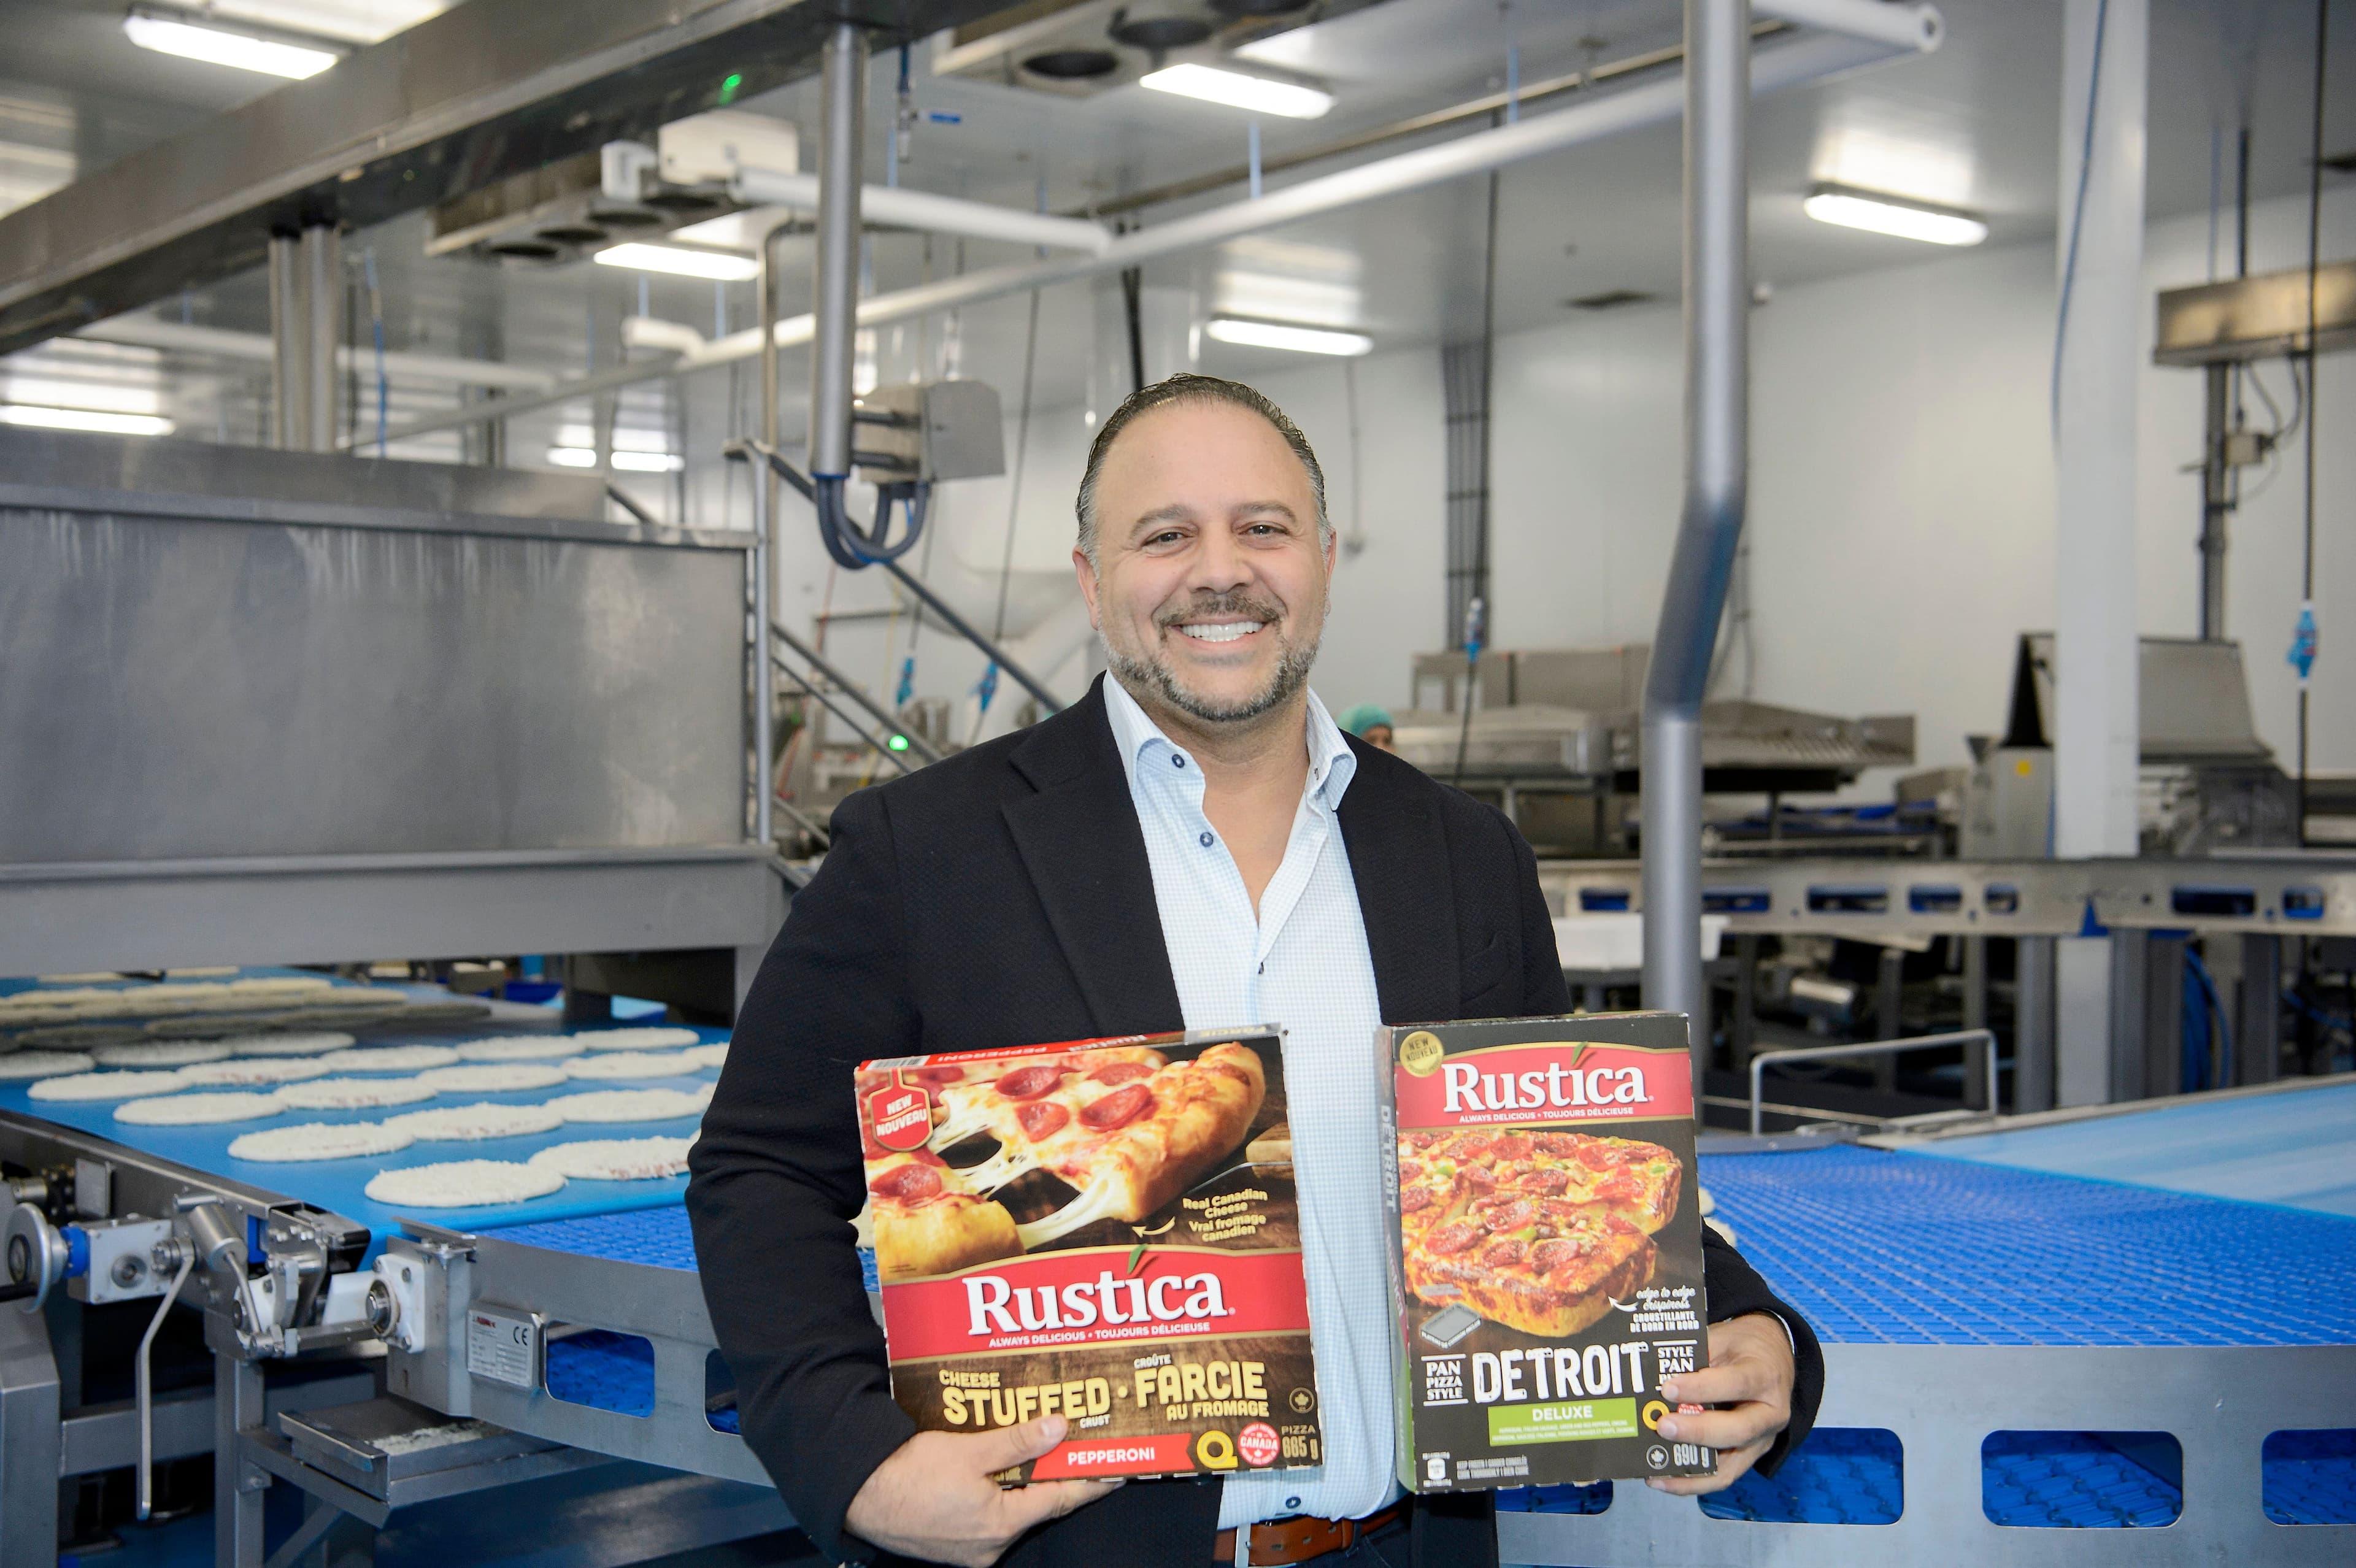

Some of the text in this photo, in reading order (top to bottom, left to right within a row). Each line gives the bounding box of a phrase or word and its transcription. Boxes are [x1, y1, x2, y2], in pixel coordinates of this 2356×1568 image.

[1441, 1062, 1648, 1113] Rustica
[887, 1094, 912, 1115] NEW
[876, 1108, 928, 1137] NOUVEAU
[1459, 1107, 1634, 1123] ALWAYS DELICIOUS TOUJOURS DÉLICIEUSE
[1182, 1188, 1268, 1210] Real Canadian
[1204, 1202, 1249, 1218] Cheese
[1188, 1214, 1267, 1232] Vrai fromage
[1202, 1225, 1257, 1242] canadien
[962, 1270, 1228, 1335] Rustica
[1636, 1285, 1696, 1302] edge to edge
[988, 1321, 1211, 1348] ALWAYS DELICIOUS TOUJOURS DÉLICIEUSE
[1658, 1345, 1694, 1358] STYLE
[1426, 1360, 1461, 1377] PAN
[1472, 1342, 1649, 1404] DETROIT
[1658, 1358, 1694, 1373] PAN
[938, 1369, 1000, 1388] CHEESE
[1134, 1361, 1268, 1407] FARCIE
[1426, 1375, 1463, 1389] PIZZA
[942, 1377, 1111, 1427] STUFFED
[1426, 1387, 1463, 1401] STYLE
[1166, 1400, 1269, 1421] AU FROMAGE
[1532, 1405, 1593, 1422] DELUXE
[1080, 1414, 1111, 1429] CRUST
[1281, 1424, 1317, 1435] PIZZA
[1240, 1435, 1279, 1450] CANADA
[1309, 1439, 1319, 1461] g
[1068, 1447, 1155, 1466] PEPPERONI
[1700, 1447, 1710, 1467] g
